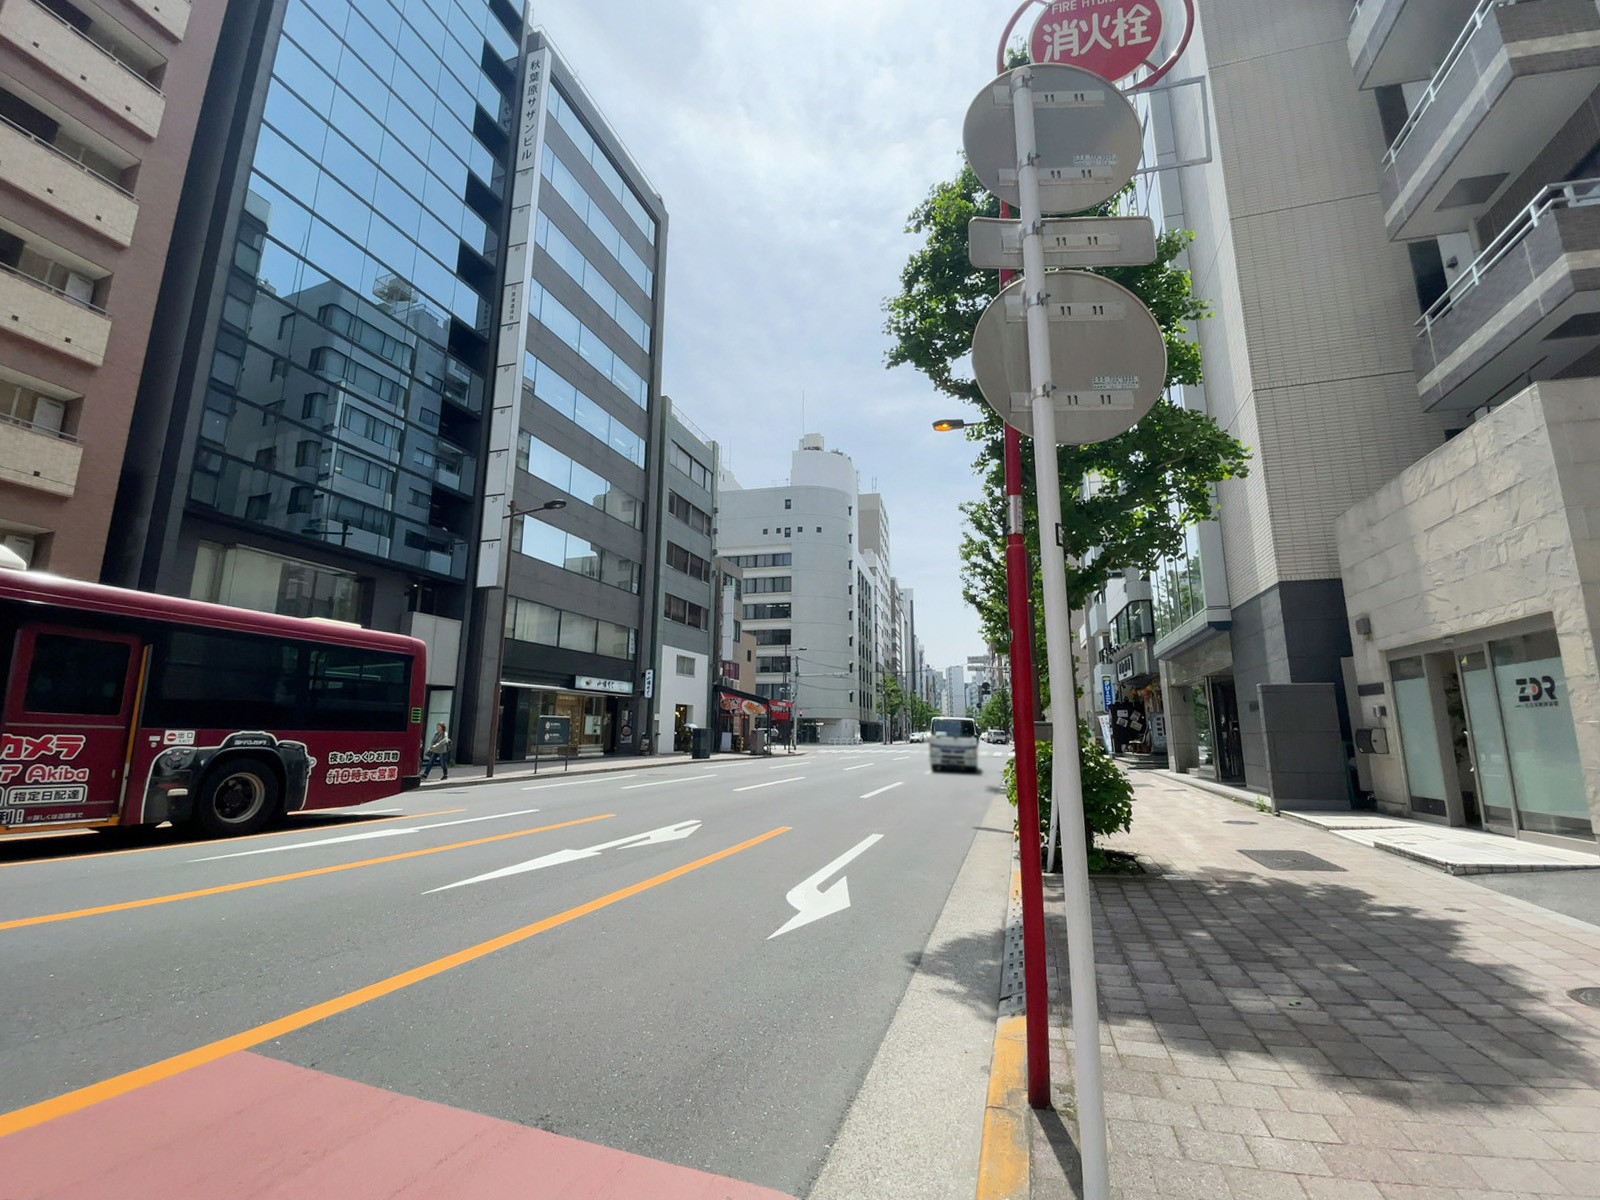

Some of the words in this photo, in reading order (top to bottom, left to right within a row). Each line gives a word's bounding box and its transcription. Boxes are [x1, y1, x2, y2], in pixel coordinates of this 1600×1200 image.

[1052, 0, 1077, 15] FIRE
[1042, 4, 1152, 63] 消火栓
[521, 59, 541, 160] 秋葉原サザンビル
[0, 734, 86, 760] カメラ
[25, 764, 89, 783] Akiba
[13, 788, 80, 802] 指定日配達
